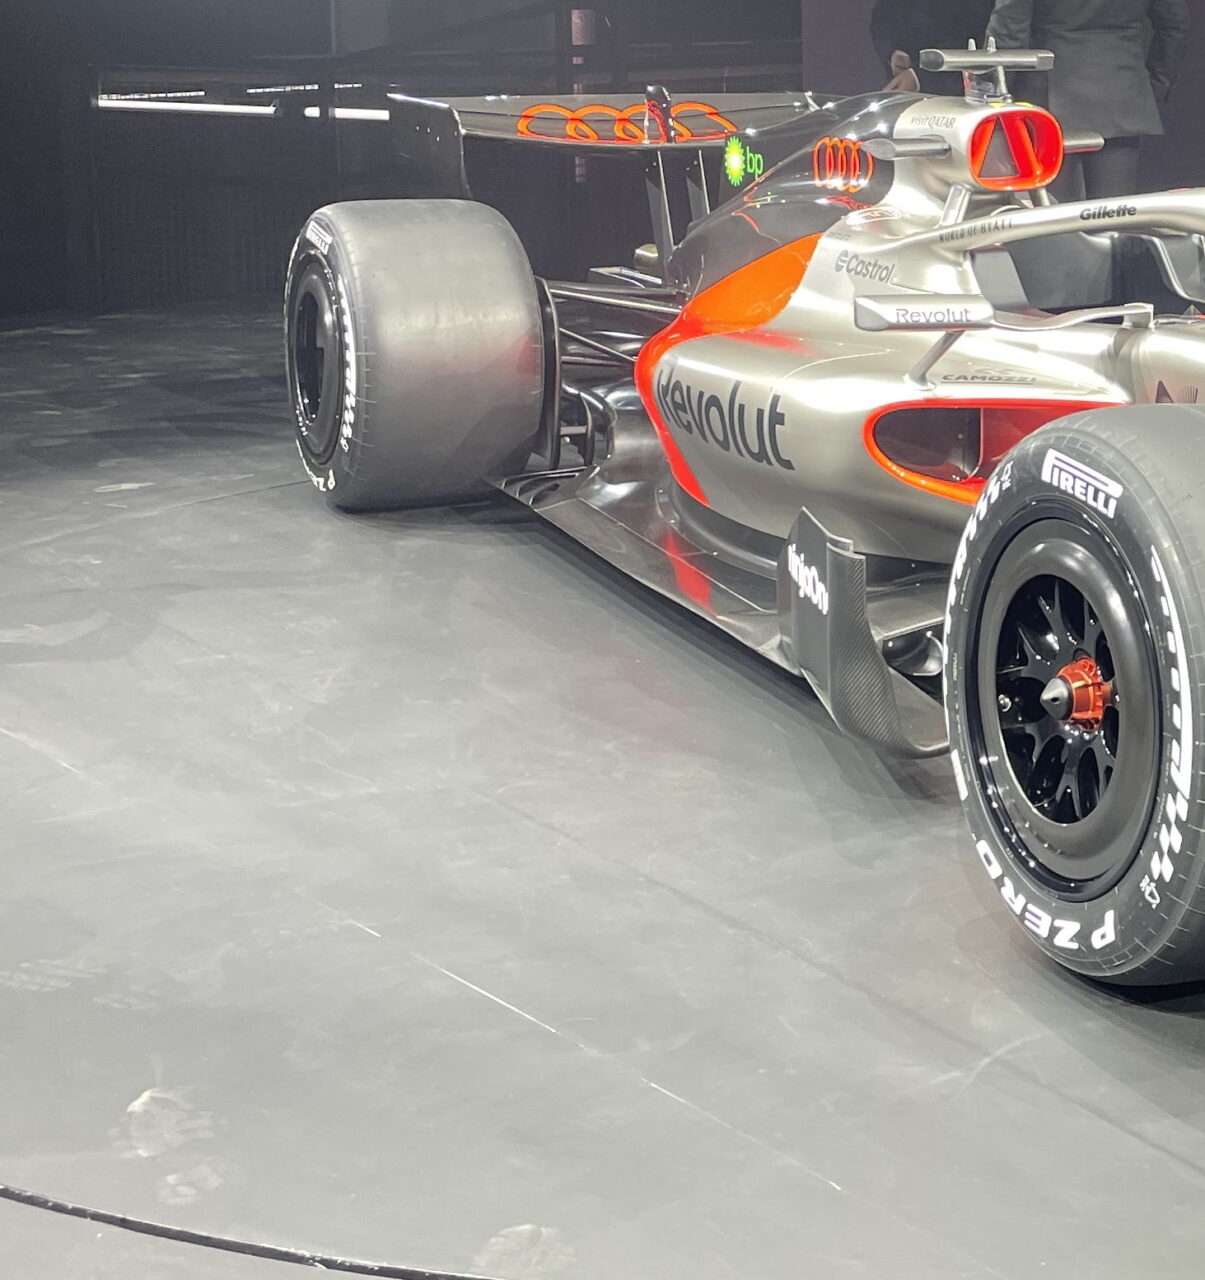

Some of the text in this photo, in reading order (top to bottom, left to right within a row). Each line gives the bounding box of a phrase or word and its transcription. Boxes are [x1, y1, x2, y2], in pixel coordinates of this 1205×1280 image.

[746, 146, 763, 180] bp
[1079, 203, 1138, 220] Gillette
[849, 252, 896, 284] Castrol
[895, 308, 971, 324] Revolut
[1041, 448, 1124, 519] PIRELLI
[787, 543, 829, 615] ninjaOn
[975, 839, 1116, 950] P ZERO
